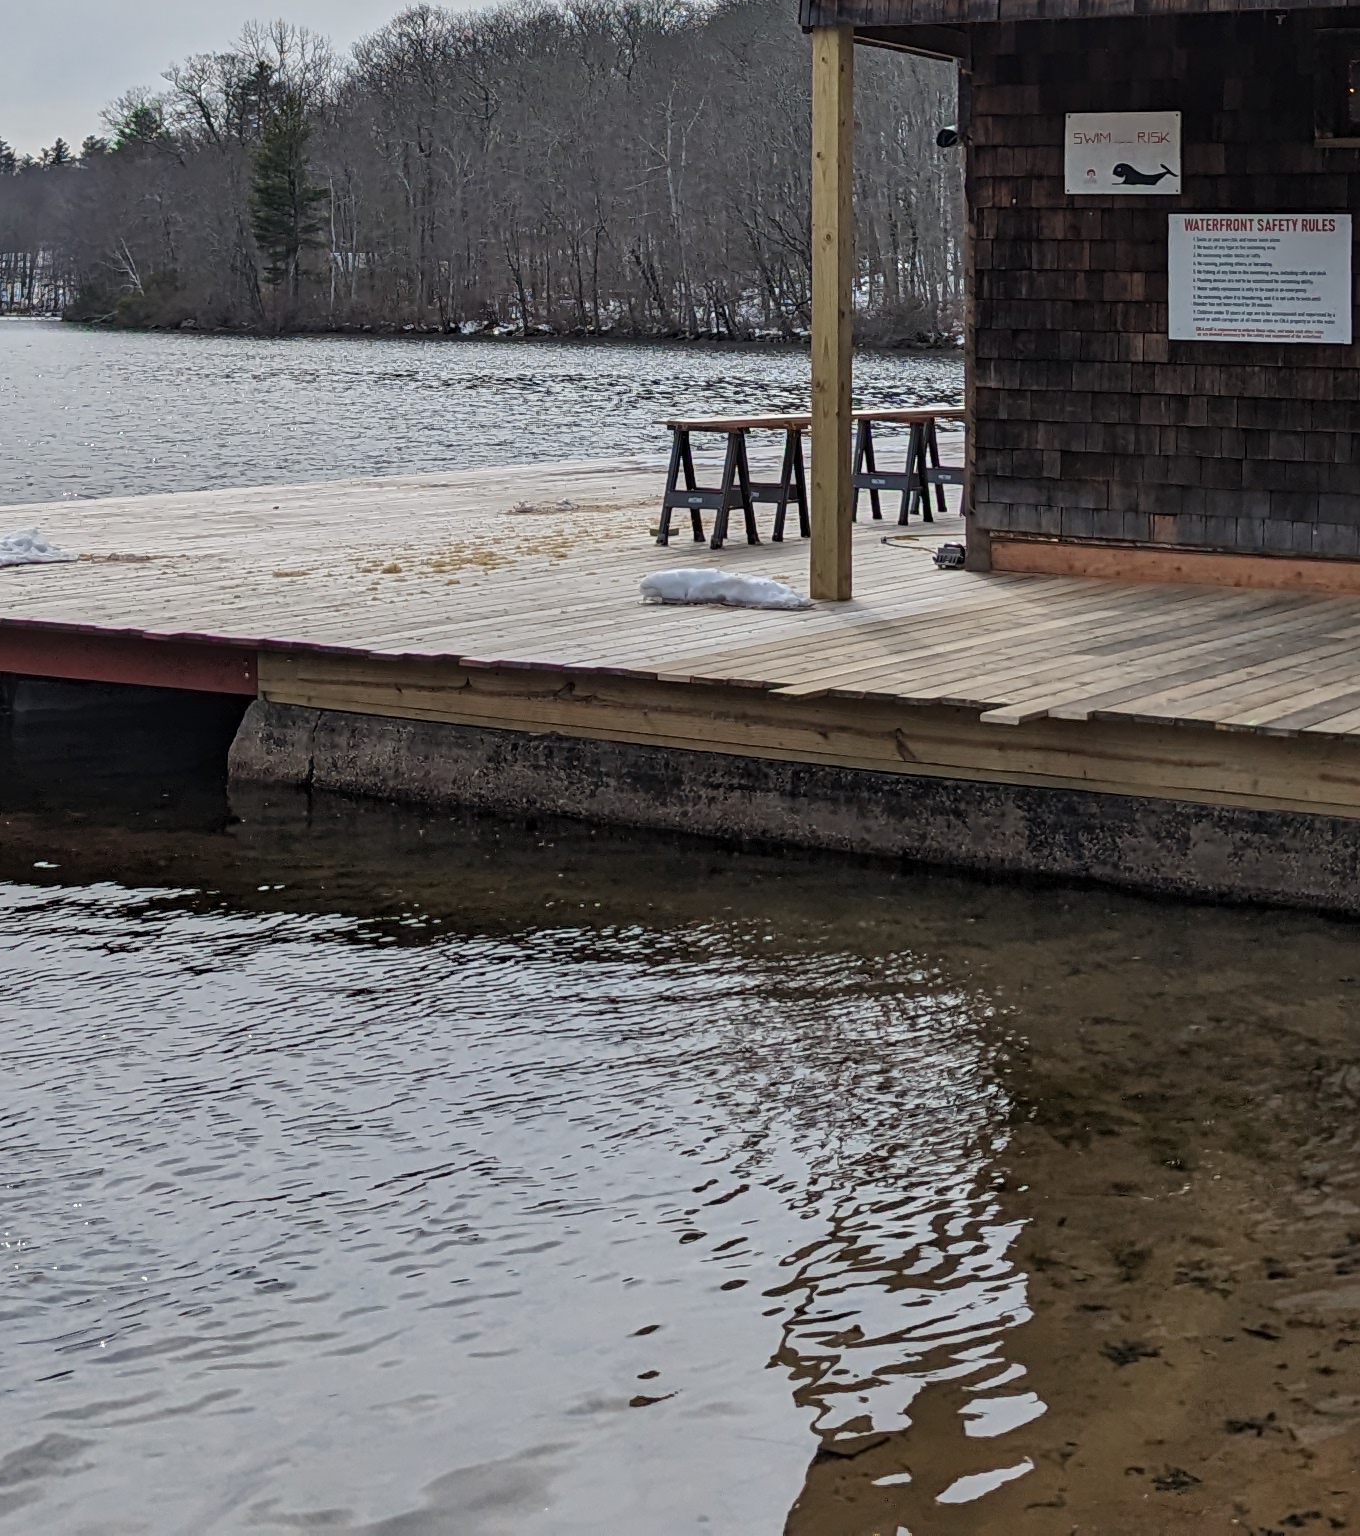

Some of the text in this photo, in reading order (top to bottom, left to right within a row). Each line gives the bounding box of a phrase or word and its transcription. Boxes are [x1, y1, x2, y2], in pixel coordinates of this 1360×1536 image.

[1073, 131, 1170, 144] SWIM RISK
[1184, 218, 1336, 232] WATERFRONT SAFETY RULES
